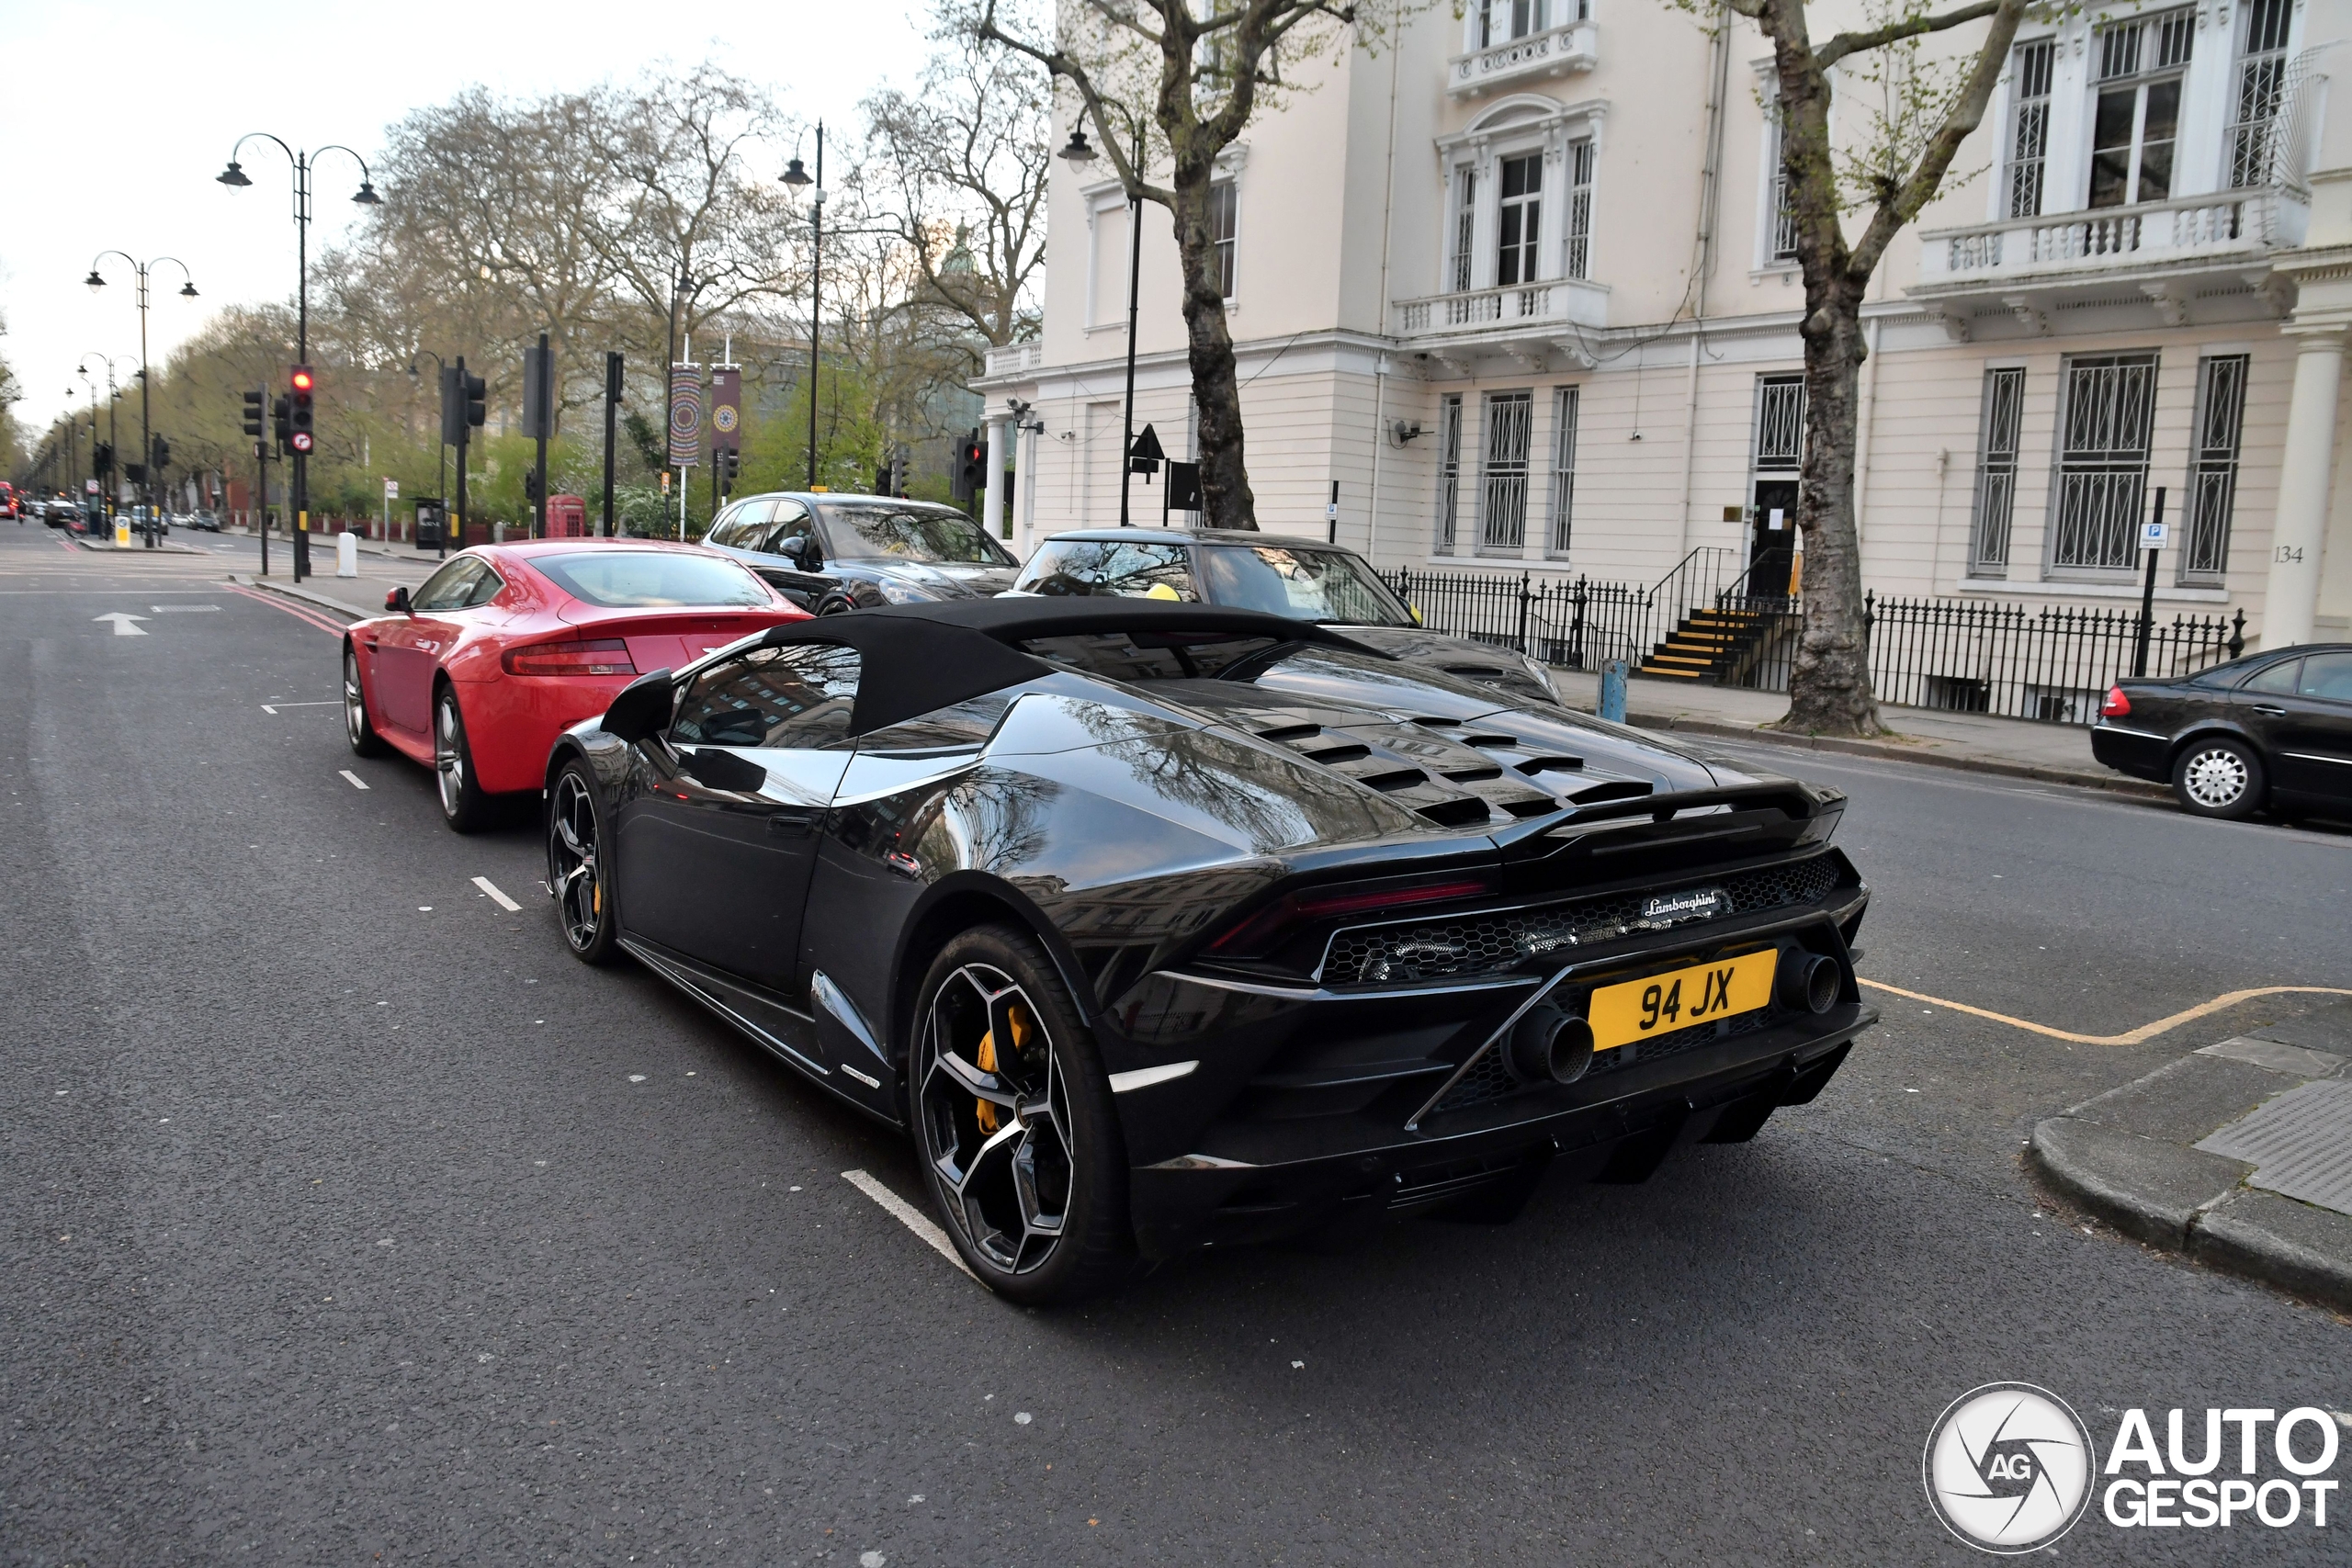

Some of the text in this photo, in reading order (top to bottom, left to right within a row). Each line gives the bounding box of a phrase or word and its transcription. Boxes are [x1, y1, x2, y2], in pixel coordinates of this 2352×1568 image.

[2151, 526, 2159, 536] P
[2274, 545, 2304, 564] 134
[1645, 891, 1717, 917] Lamborghini
[1639, 966, 1735, 1031] 94 JX
